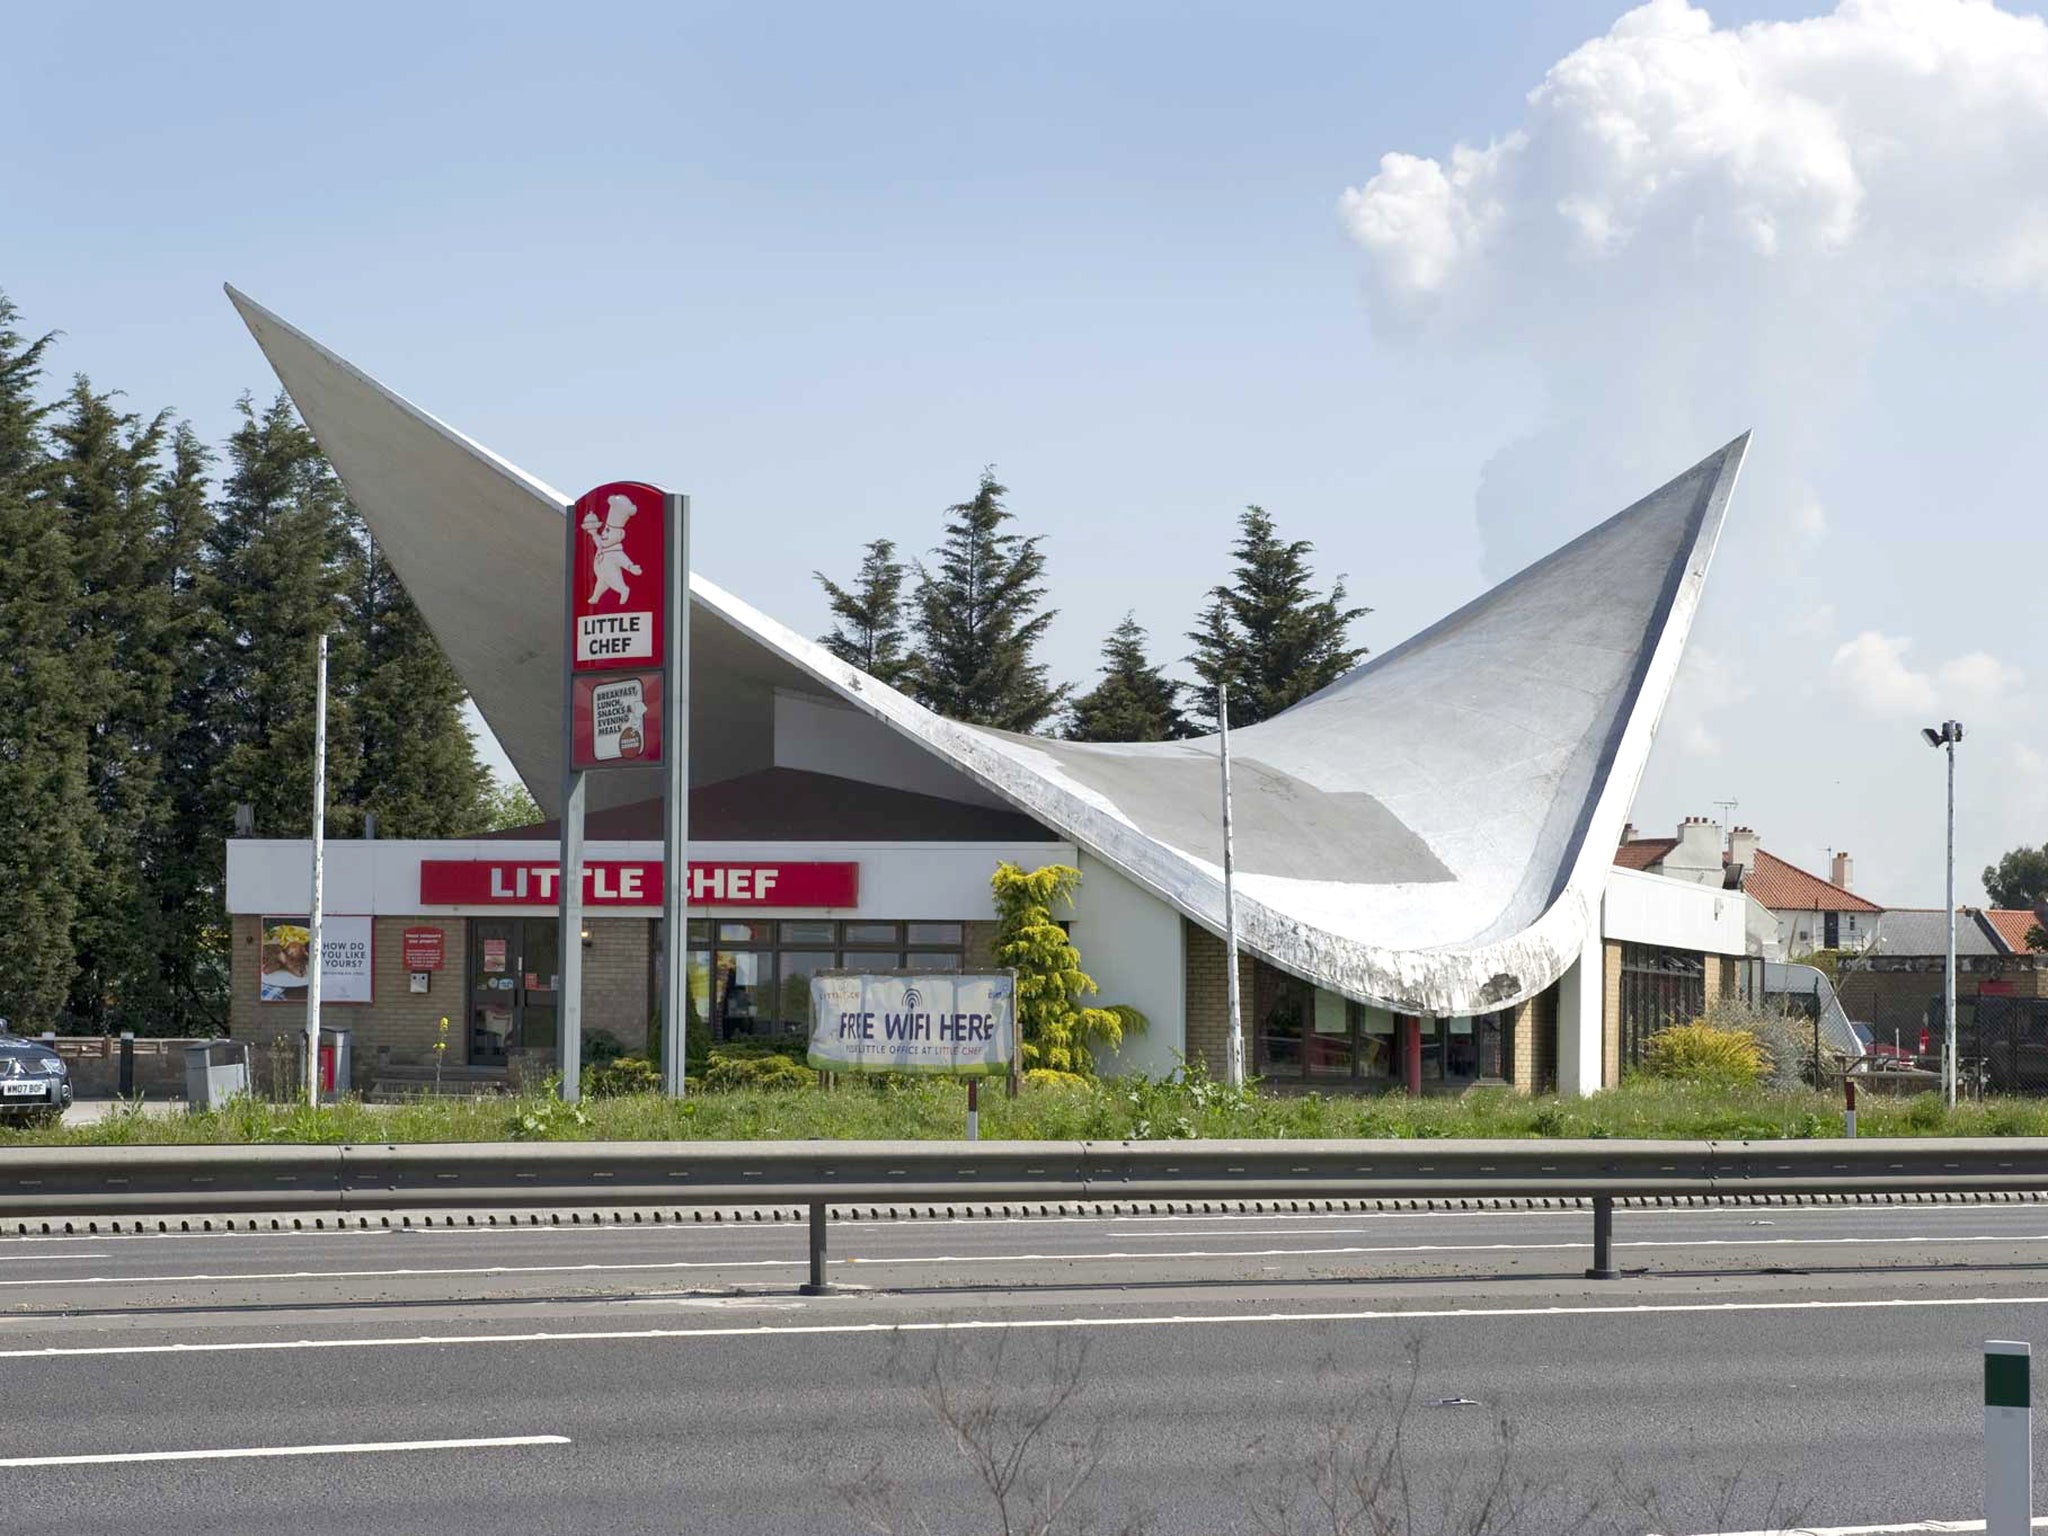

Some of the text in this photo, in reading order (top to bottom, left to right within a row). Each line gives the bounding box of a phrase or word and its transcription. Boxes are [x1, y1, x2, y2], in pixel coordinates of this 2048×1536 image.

[584, 616, 641, 636] LITTLE
[589, 637, 632, 655] CHEF
[596, 686, 639, 701] BREAKFAST,
[596, 699, 623, 711] LUNCH,
[597, 706, 625, 718] SNACKS
[597, 714, 630, 727] EVENING
[597, 725, 621, 737] MEALS
[490, 867, 779, 900] LITLE HEF
[323, 942, 365, 950] HOW DO
[321, 950, 366, 959] YOU LIKE
[325, 959, 363, 968] YOURS?
[839, 1012, 875, 1040] FREE
[939, 1013, 994, 1041] HERE
[858, 1044, 886, 1054] LITTLE
[889, 1045, 918, 1055] OFFICE
[921, 1046, 932, 1055] AT
[935, 1046, 959, 1056] LITTLE
[961, 1046, 983, 1056] CHEF
